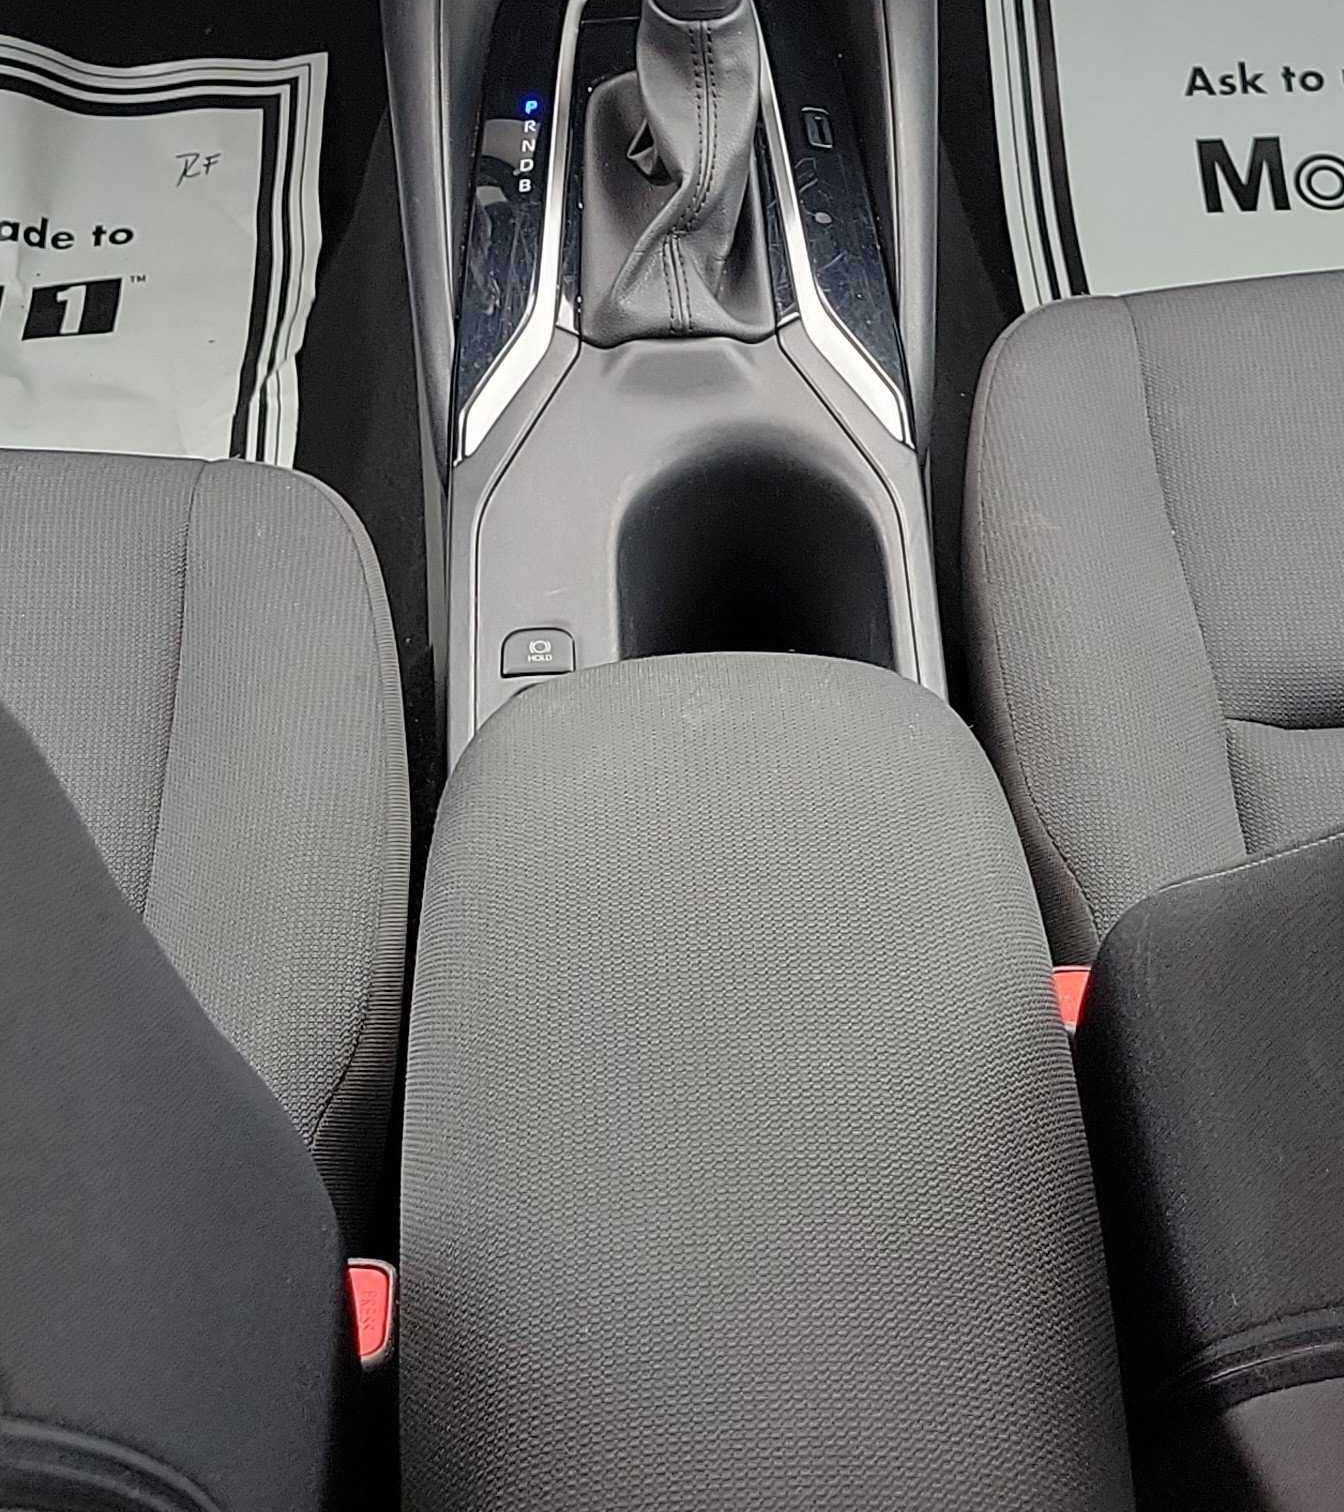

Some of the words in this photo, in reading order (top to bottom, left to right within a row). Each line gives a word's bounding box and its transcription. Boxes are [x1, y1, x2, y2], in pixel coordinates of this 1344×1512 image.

[1185, 61, 1267, 96] Ask
[1282, 65, 1324, 92] to
[525, 99, 538, 115] P
[523, 119, 537, 134] R
[521, 138, 536, 153] N
[519, 158, 534, 173] D
[518, 178, 532, 193] B
[92, 224, 135, 247] to
[527, 653, 553, 663] HOLD
